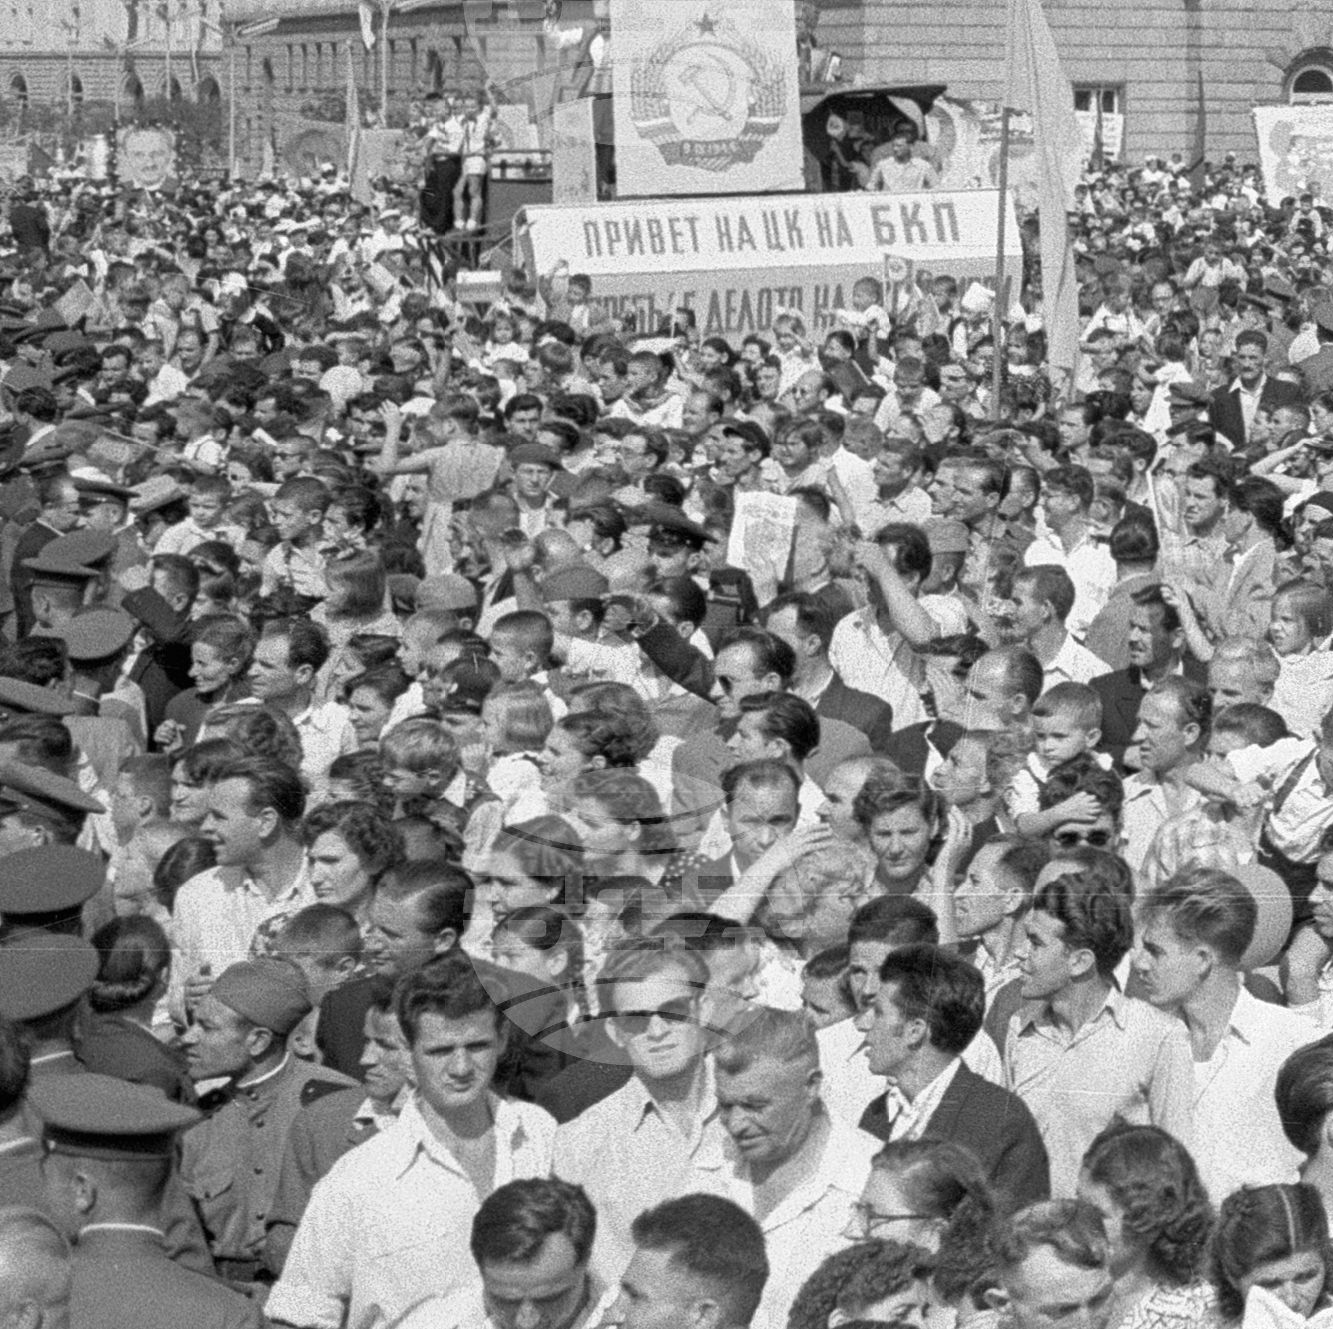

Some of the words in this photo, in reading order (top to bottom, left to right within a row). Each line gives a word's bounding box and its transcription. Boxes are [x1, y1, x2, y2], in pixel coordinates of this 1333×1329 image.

[584, 217, 699, 258] ПРИВЕТ
[715, 214, 757, 253] НА
[762, 209, 805, 252] ЦК
[815, 210, 854, 248] НА
[870, 201, 961, 246] БКП
